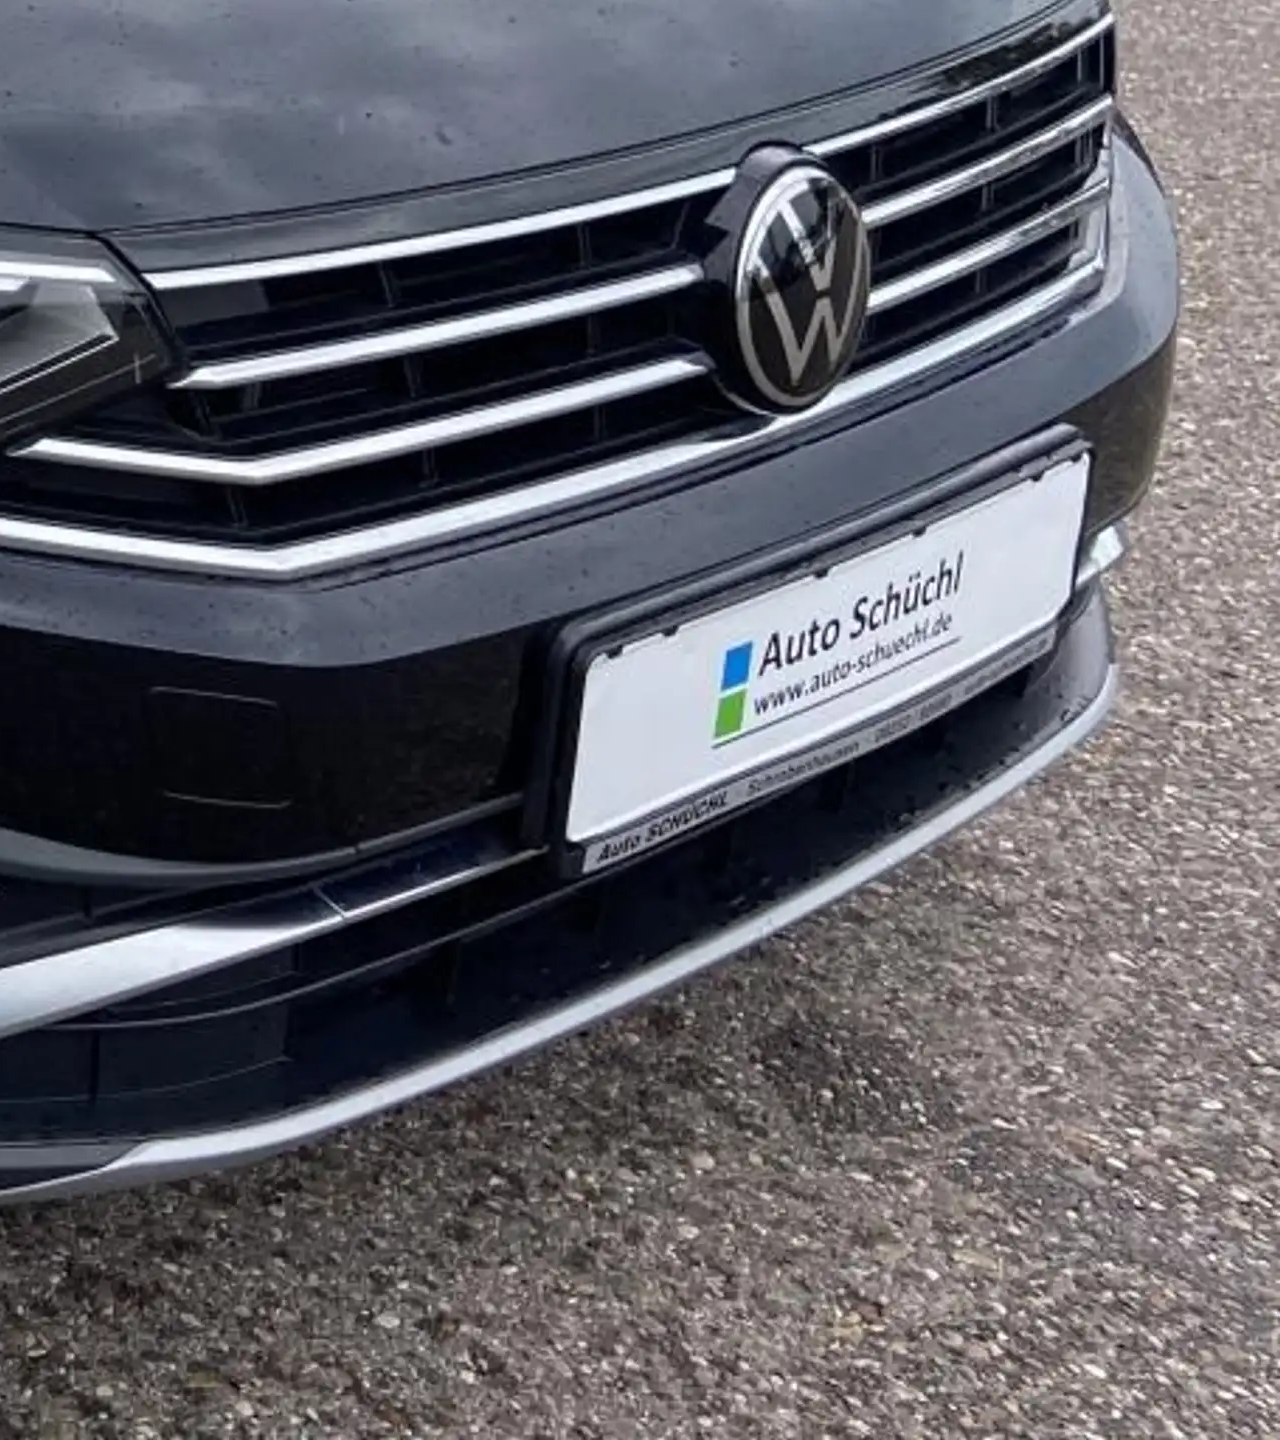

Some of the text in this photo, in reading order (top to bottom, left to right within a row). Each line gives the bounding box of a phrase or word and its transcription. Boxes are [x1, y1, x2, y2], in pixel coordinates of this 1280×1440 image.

[754, 611, 953, 715] www.auto-schuechl.de
[758, 549, 964, 676] Auto Schüchl
